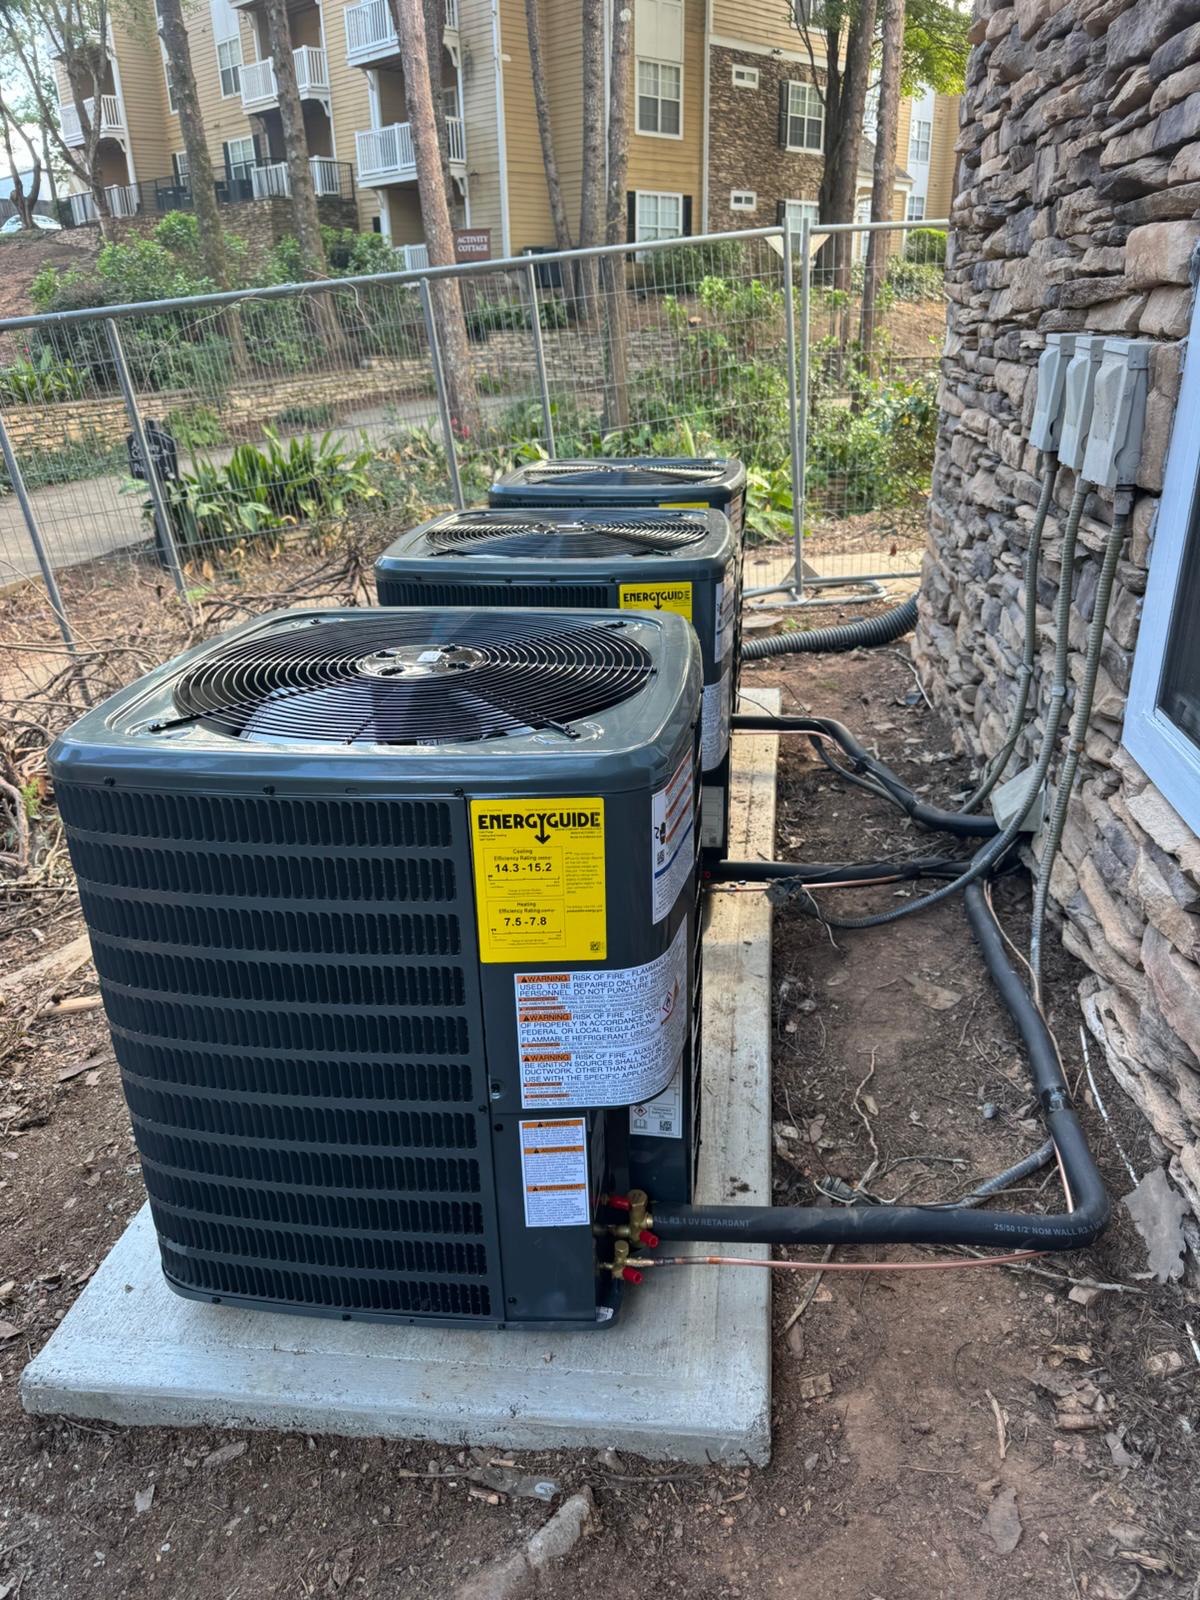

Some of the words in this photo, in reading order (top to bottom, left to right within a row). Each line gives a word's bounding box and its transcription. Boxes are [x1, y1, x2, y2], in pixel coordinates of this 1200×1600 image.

[457, 235, 489, 244] ACTIVITY
[457, 244, 489, 252] COTTAGE
[623, 590, 690, 602] ENERGYGUIDE
[478, 812, 601, 830] ENERGYGUIDE
[528, 974, 568, 982] WARNING
[593, 973, 605, 981] OF
[607, 972, 625, 980] FIRE
[573, 980, 615, 989] REPAIRED
[616, 977, 638, 987] ONLY
[639, 974, 649, 983] BY
[573, 988, 586, 996] DO
[588, 987, 604, 995] NOT
[607, 982, 649, 994] PUNCTURE
[529, 1013, 570, 1021] WARNING
[606, 1011, 625, 1019] FIRE
[533, 1020, 577, 1029] PROPERLY
[588, 1015, 644, 1027] ACCORDANCE
[560, 1027, 574, 1035] OR
[575, 1026, 602, 1034] LOCAL
[521, 1035, 570, 1043] FLAMMABLE
[571, 1032, 628, 1042] REFRIGERANT
[530, 1053, 569, 1061] WARNING
[608, 1051, 626, 1059] FIRE
[537, 1060, 572, 1069] IGNITION
[574, 1059, 613, 1068] SOURCES
[615, 1058, 638, 1066] SHALL
[640, 1051, 654, 1060] NOT
[575, 1066, 603, 1074] OTHER
[604, 1065, 627, 1073] THAN
[524, 1075, 542, 1083] USE
[543, 1074, 564, 1082] WITH
[583, 1072, 620, 1081] SPECIFIC
[653, 1215, 668, 1224] ALL
[688, 1217, 700, 1226] UV
[700, 1217, 750, 1228] RETARDANT
[1031, 1226, 1052, 1235] NOM
[1053, 1228, 1078, 1236] WALL
